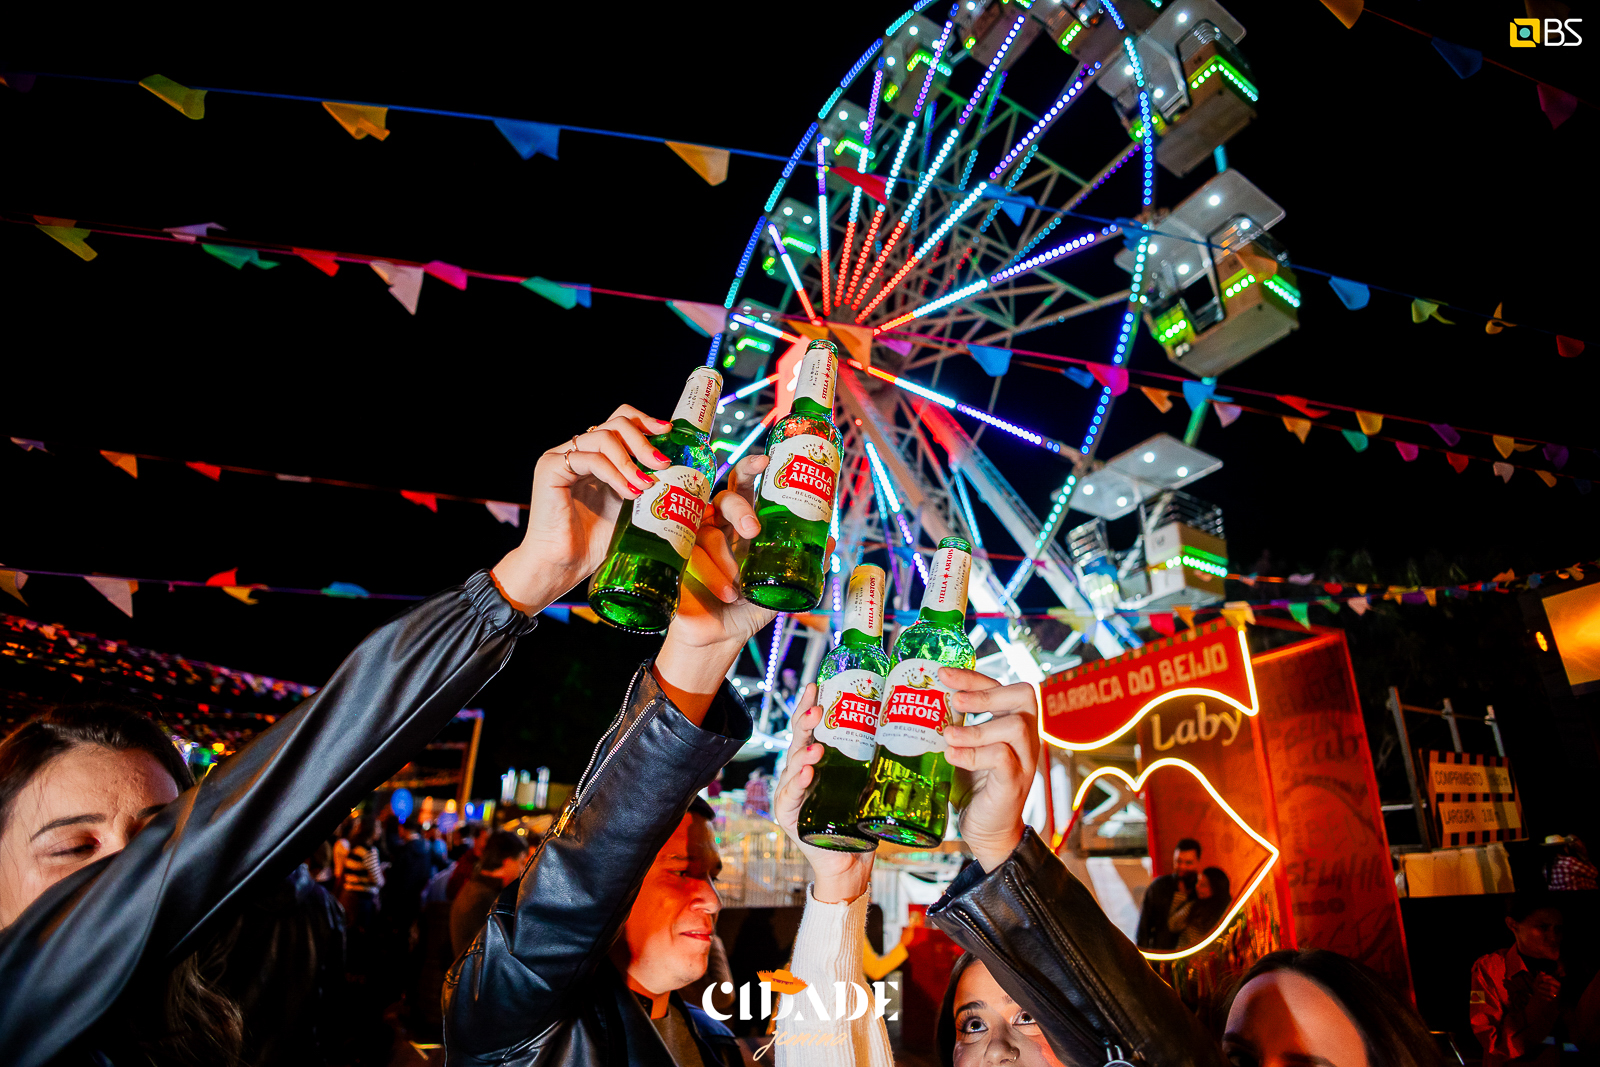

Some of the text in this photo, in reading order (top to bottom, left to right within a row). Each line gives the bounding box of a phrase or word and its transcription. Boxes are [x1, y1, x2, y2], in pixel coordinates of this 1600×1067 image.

[698, 378, 714, 423] STELLA ARTOIS
[789, 471, 832, 496] ARTOIS
[792, 462, 832, 486] STELLA
[938, 548, 954, 604] STELLA ARTOIS
[1045, 675, 1125, 717] BARRACA
[1127, 665, 1155, 696] DO
[1158, 642, 1229, 687] BEIJO
[841, 699, 879, 717] STELL
[889, 704, 940, 722] ARTOIS
[892, 692, 942, 710] STELLA
[838, 710, 879, 728] ARTOI
[894, 725, 926, 734] BELGIUM
[1151, 701, 1242, 751] Laby
